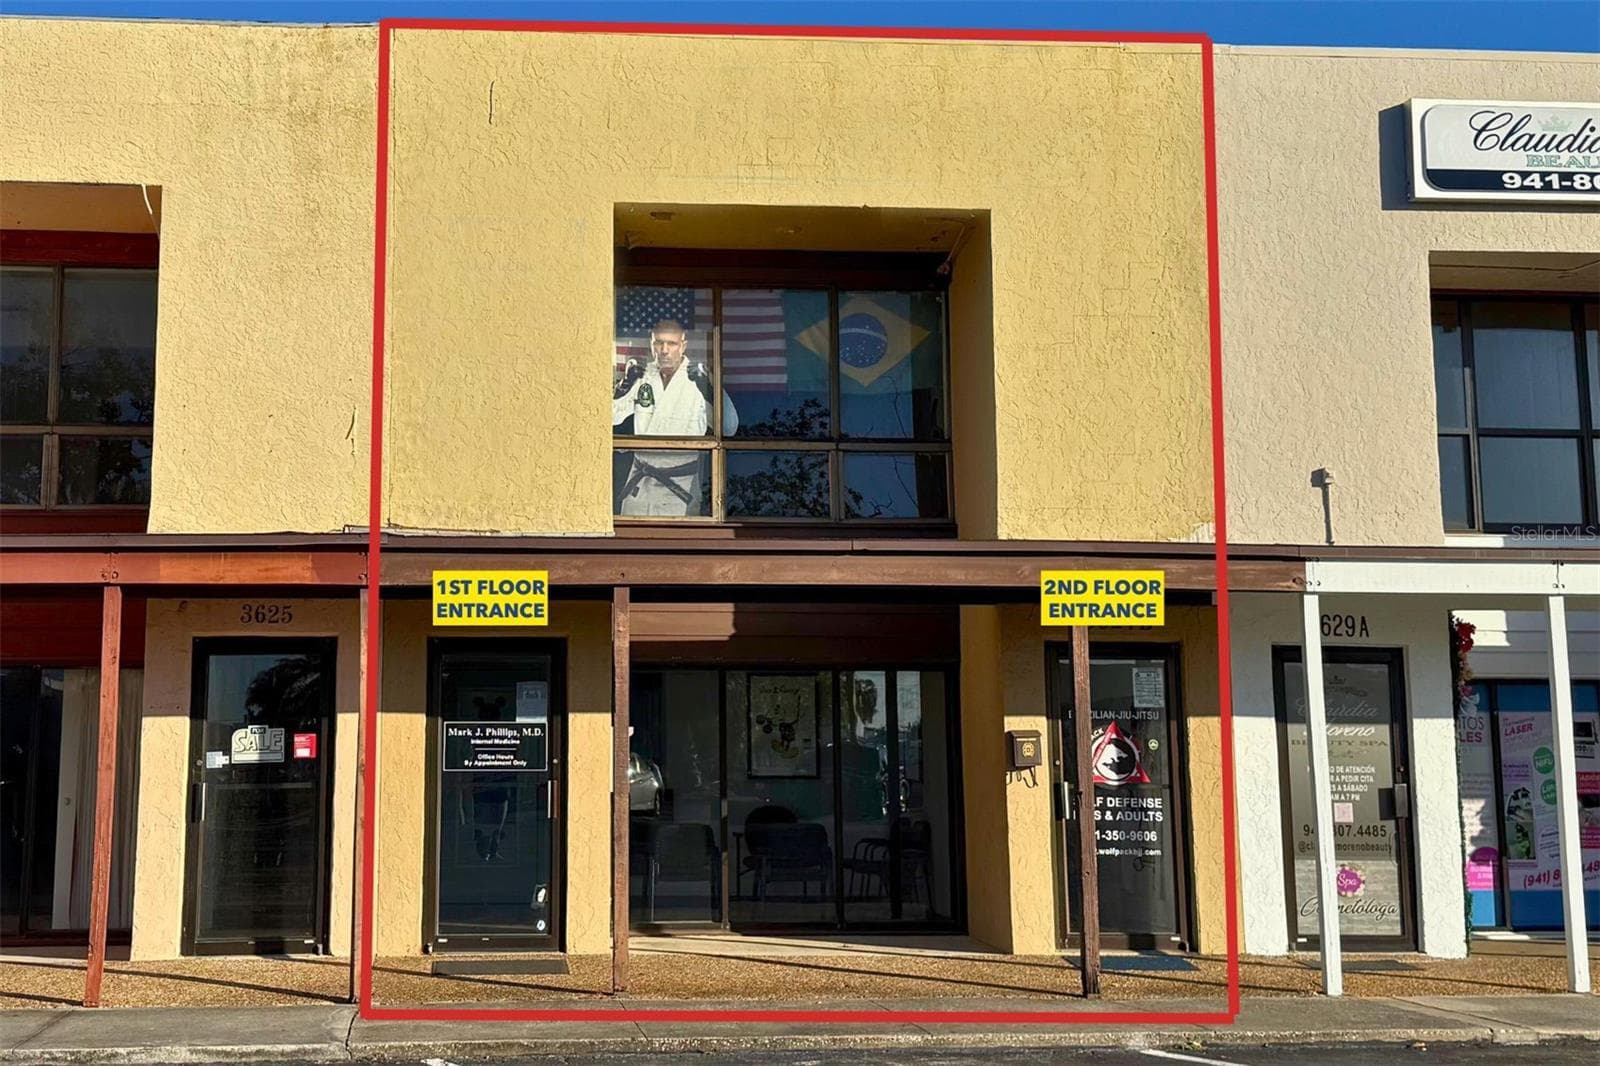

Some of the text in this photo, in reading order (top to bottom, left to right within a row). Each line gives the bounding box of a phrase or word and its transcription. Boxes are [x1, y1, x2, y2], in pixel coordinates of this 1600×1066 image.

[240, 604, 293, 624] 3625
[1320, 614, 1369, 638] 629A
[1068, 710, 1159, 720] ILIAN-JIU-JITSU
[448, 728, 544, 738] Mark J. Phillips, M.D.
[1504, 723, 1534, 736] LASER
[234, 729, 283, 752] SALE
[1107, 798, 1163, 809] DEFENSE
[1105, 811, 1114, 821] &
[1116, 811, 1164, 822] ADULTS
[1095, 830, 1158, 841] 1-350-9606
[1303, 824, 1387, 837] 907.4485
[1523, 869, 1550, 888] (941)
